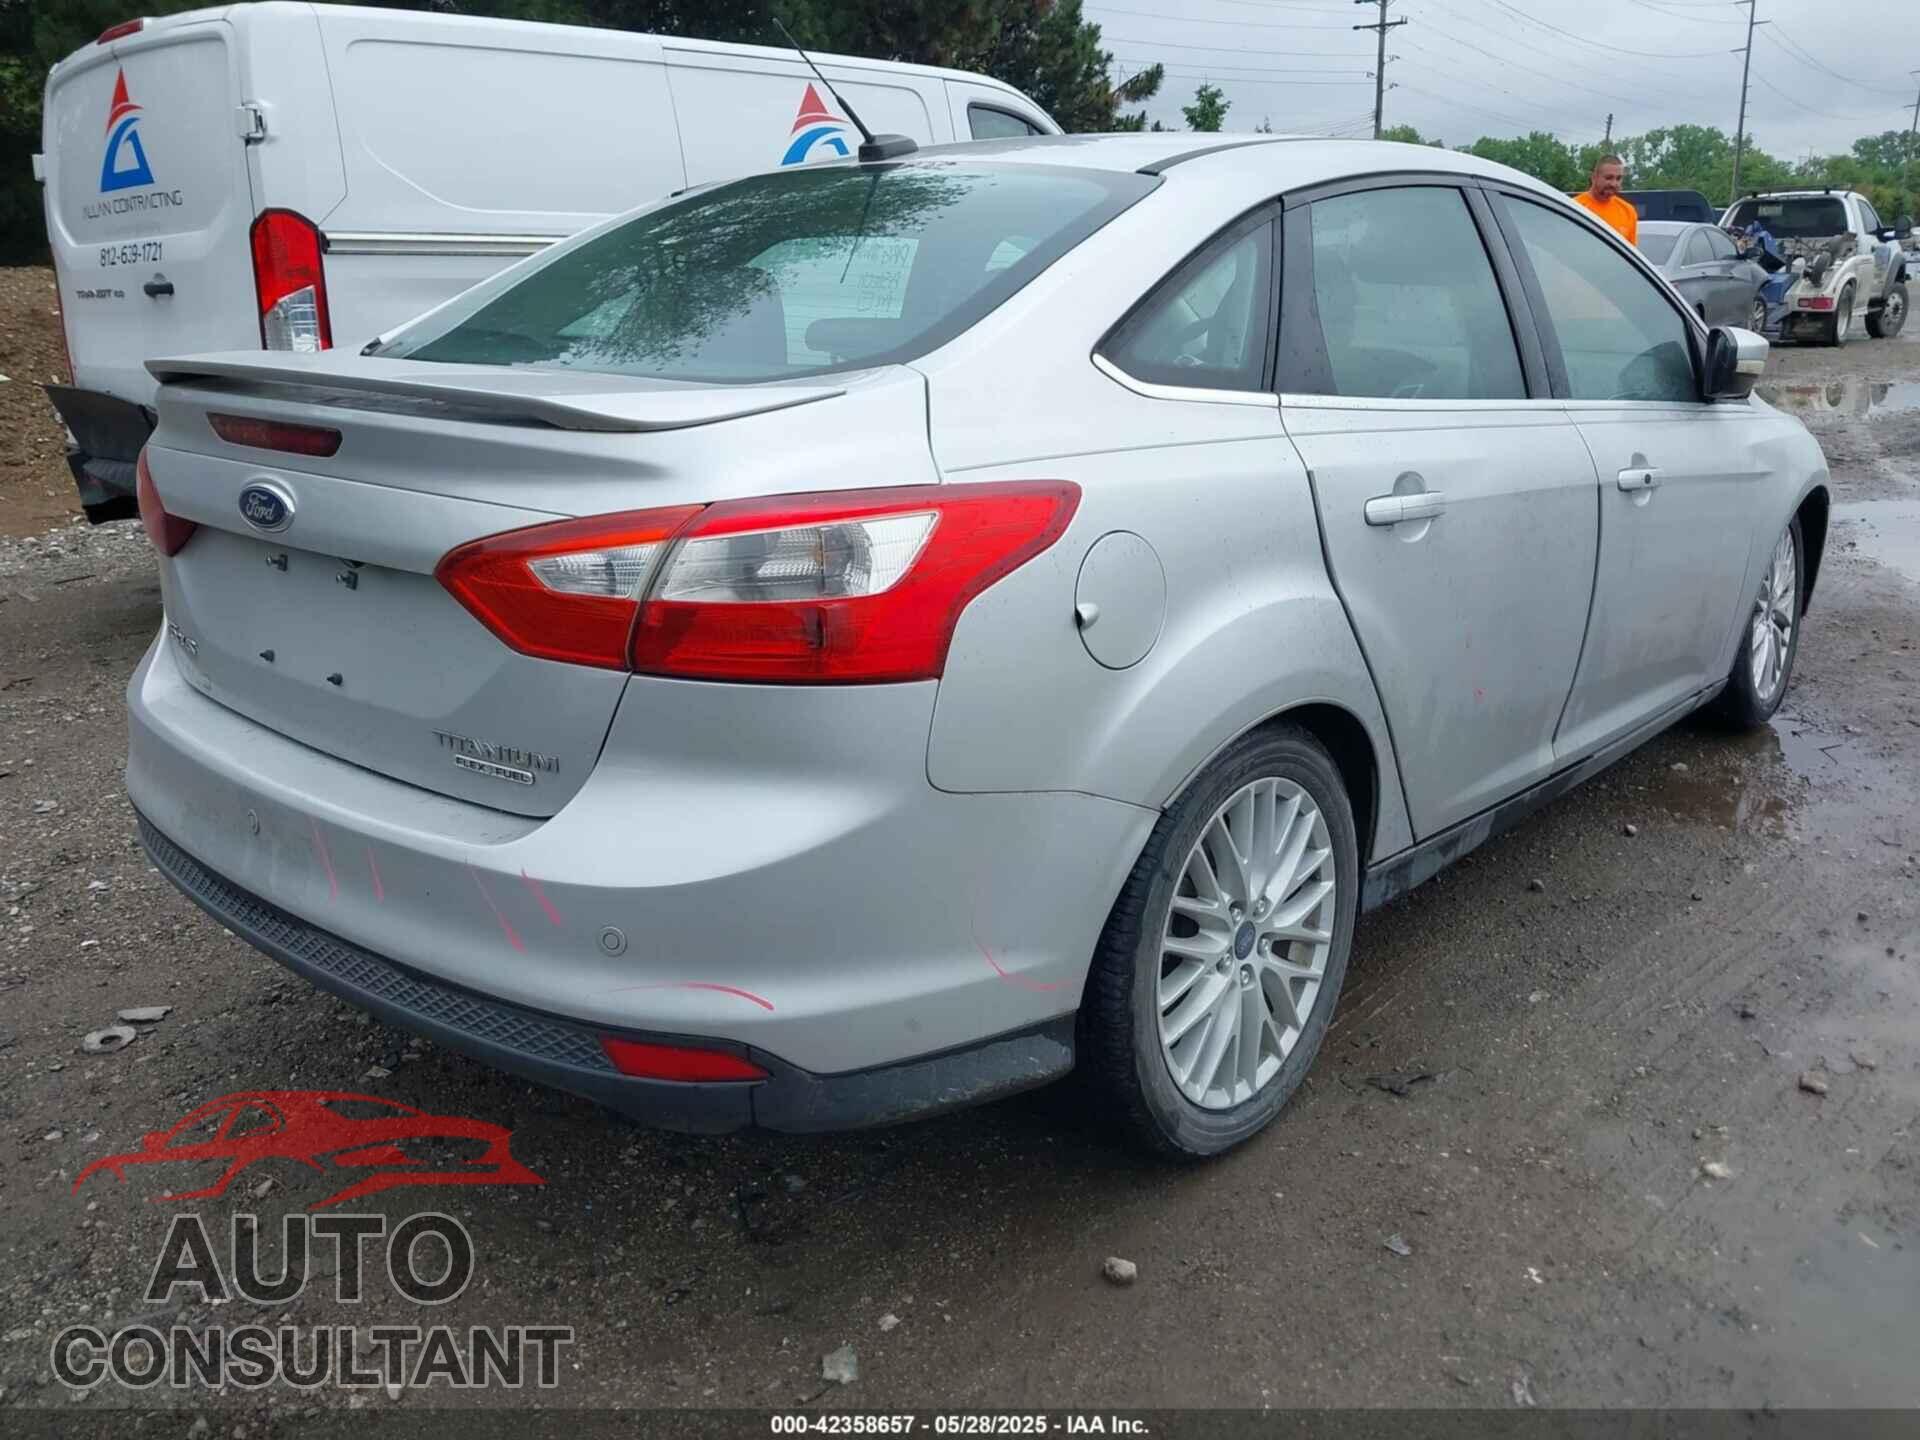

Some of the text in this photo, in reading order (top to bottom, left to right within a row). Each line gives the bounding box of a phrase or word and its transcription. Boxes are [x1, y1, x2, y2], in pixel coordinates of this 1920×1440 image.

[113, 190, 183, 214] CONTRACTING
[100, 242, 163, 267] 812-639-1721
[245, 491, 276, 521] Ford
[432, 728, 560, 773] TITANIUM
[495, 766, 532, 782] FUEL
